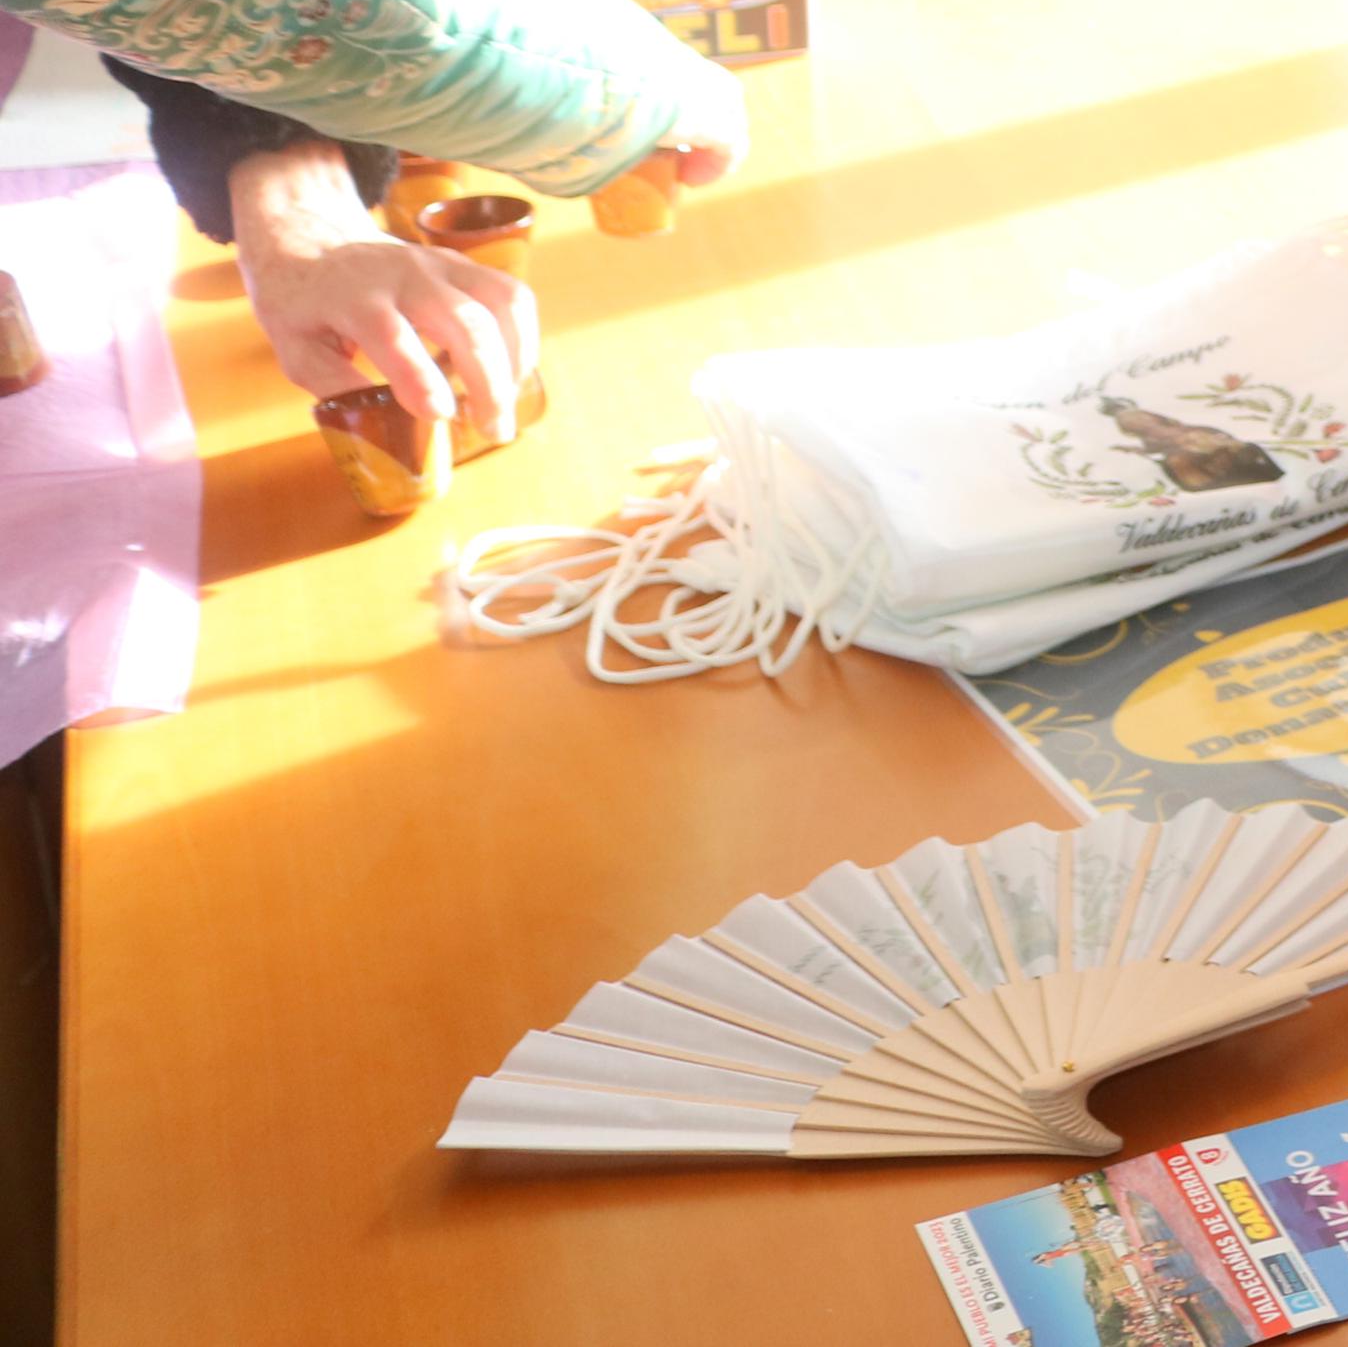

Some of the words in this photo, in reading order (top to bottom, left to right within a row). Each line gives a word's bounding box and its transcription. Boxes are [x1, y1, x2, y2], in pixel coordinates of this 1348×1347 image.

[1269, 495, 1299, 520] de
[1168, 1154, 1218, 1214] CERRATO
[1286, 1150, 1339, 1197] AÑO
[1202, 1214, 1230, 1235] DE
[1217, 1180, 1273, 1241] GADIS
[950, 1217, 982, 1267] Palentino
[973, 1267, 1000, 1302] Diario
[1215, 1235, 1281, 1324] VALDECAÑAS
